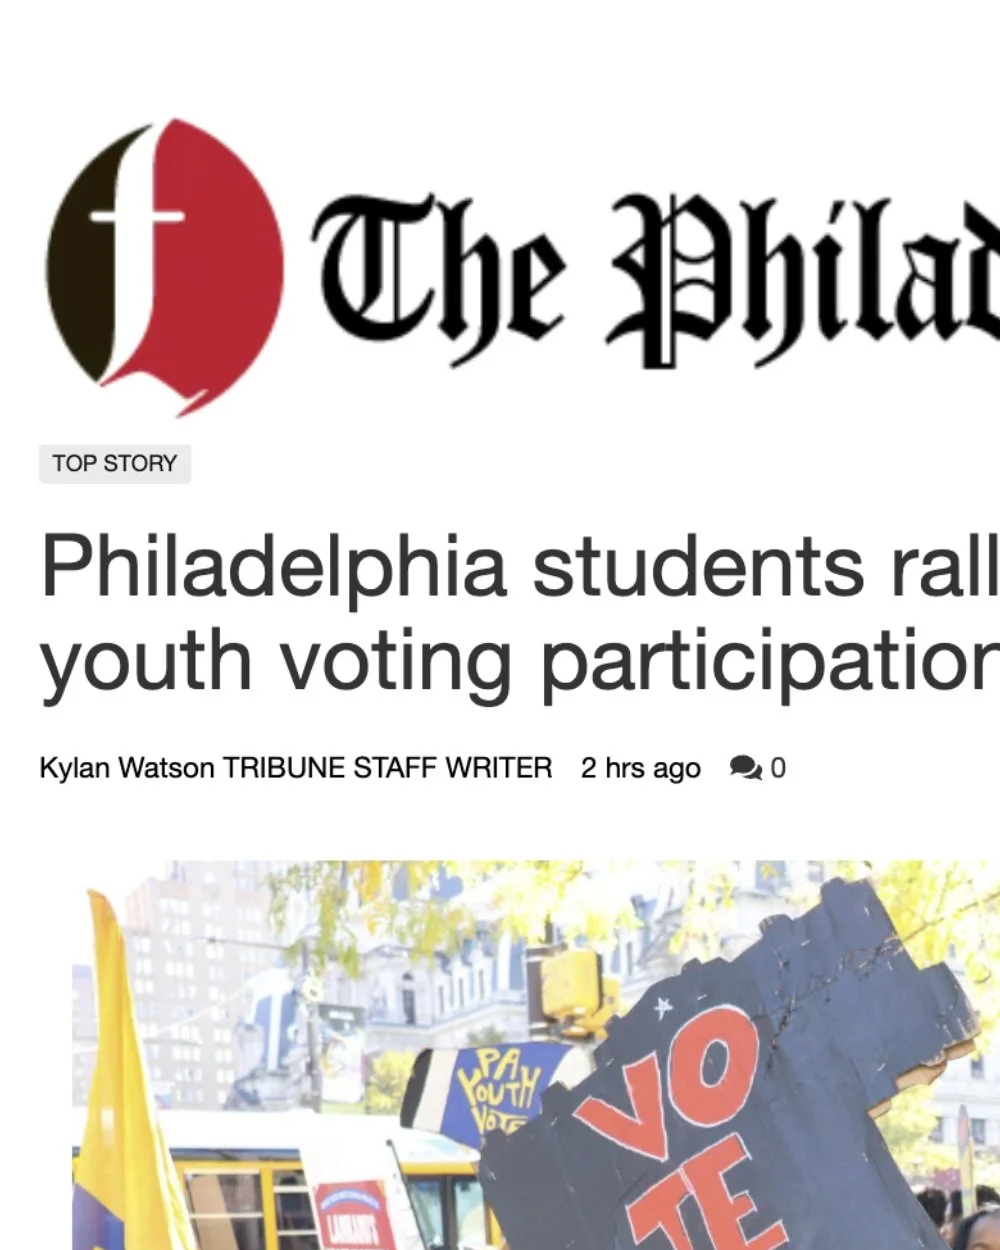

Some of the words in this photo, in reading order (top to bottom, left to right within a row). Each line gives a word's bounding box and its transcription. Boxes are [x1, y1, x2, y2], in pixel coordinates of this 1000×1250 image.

[476, 1047, 521, 1080] PA
[572, 1003, 760, 1163] VO
[457, 1066, 542, 1110] YOUTH
